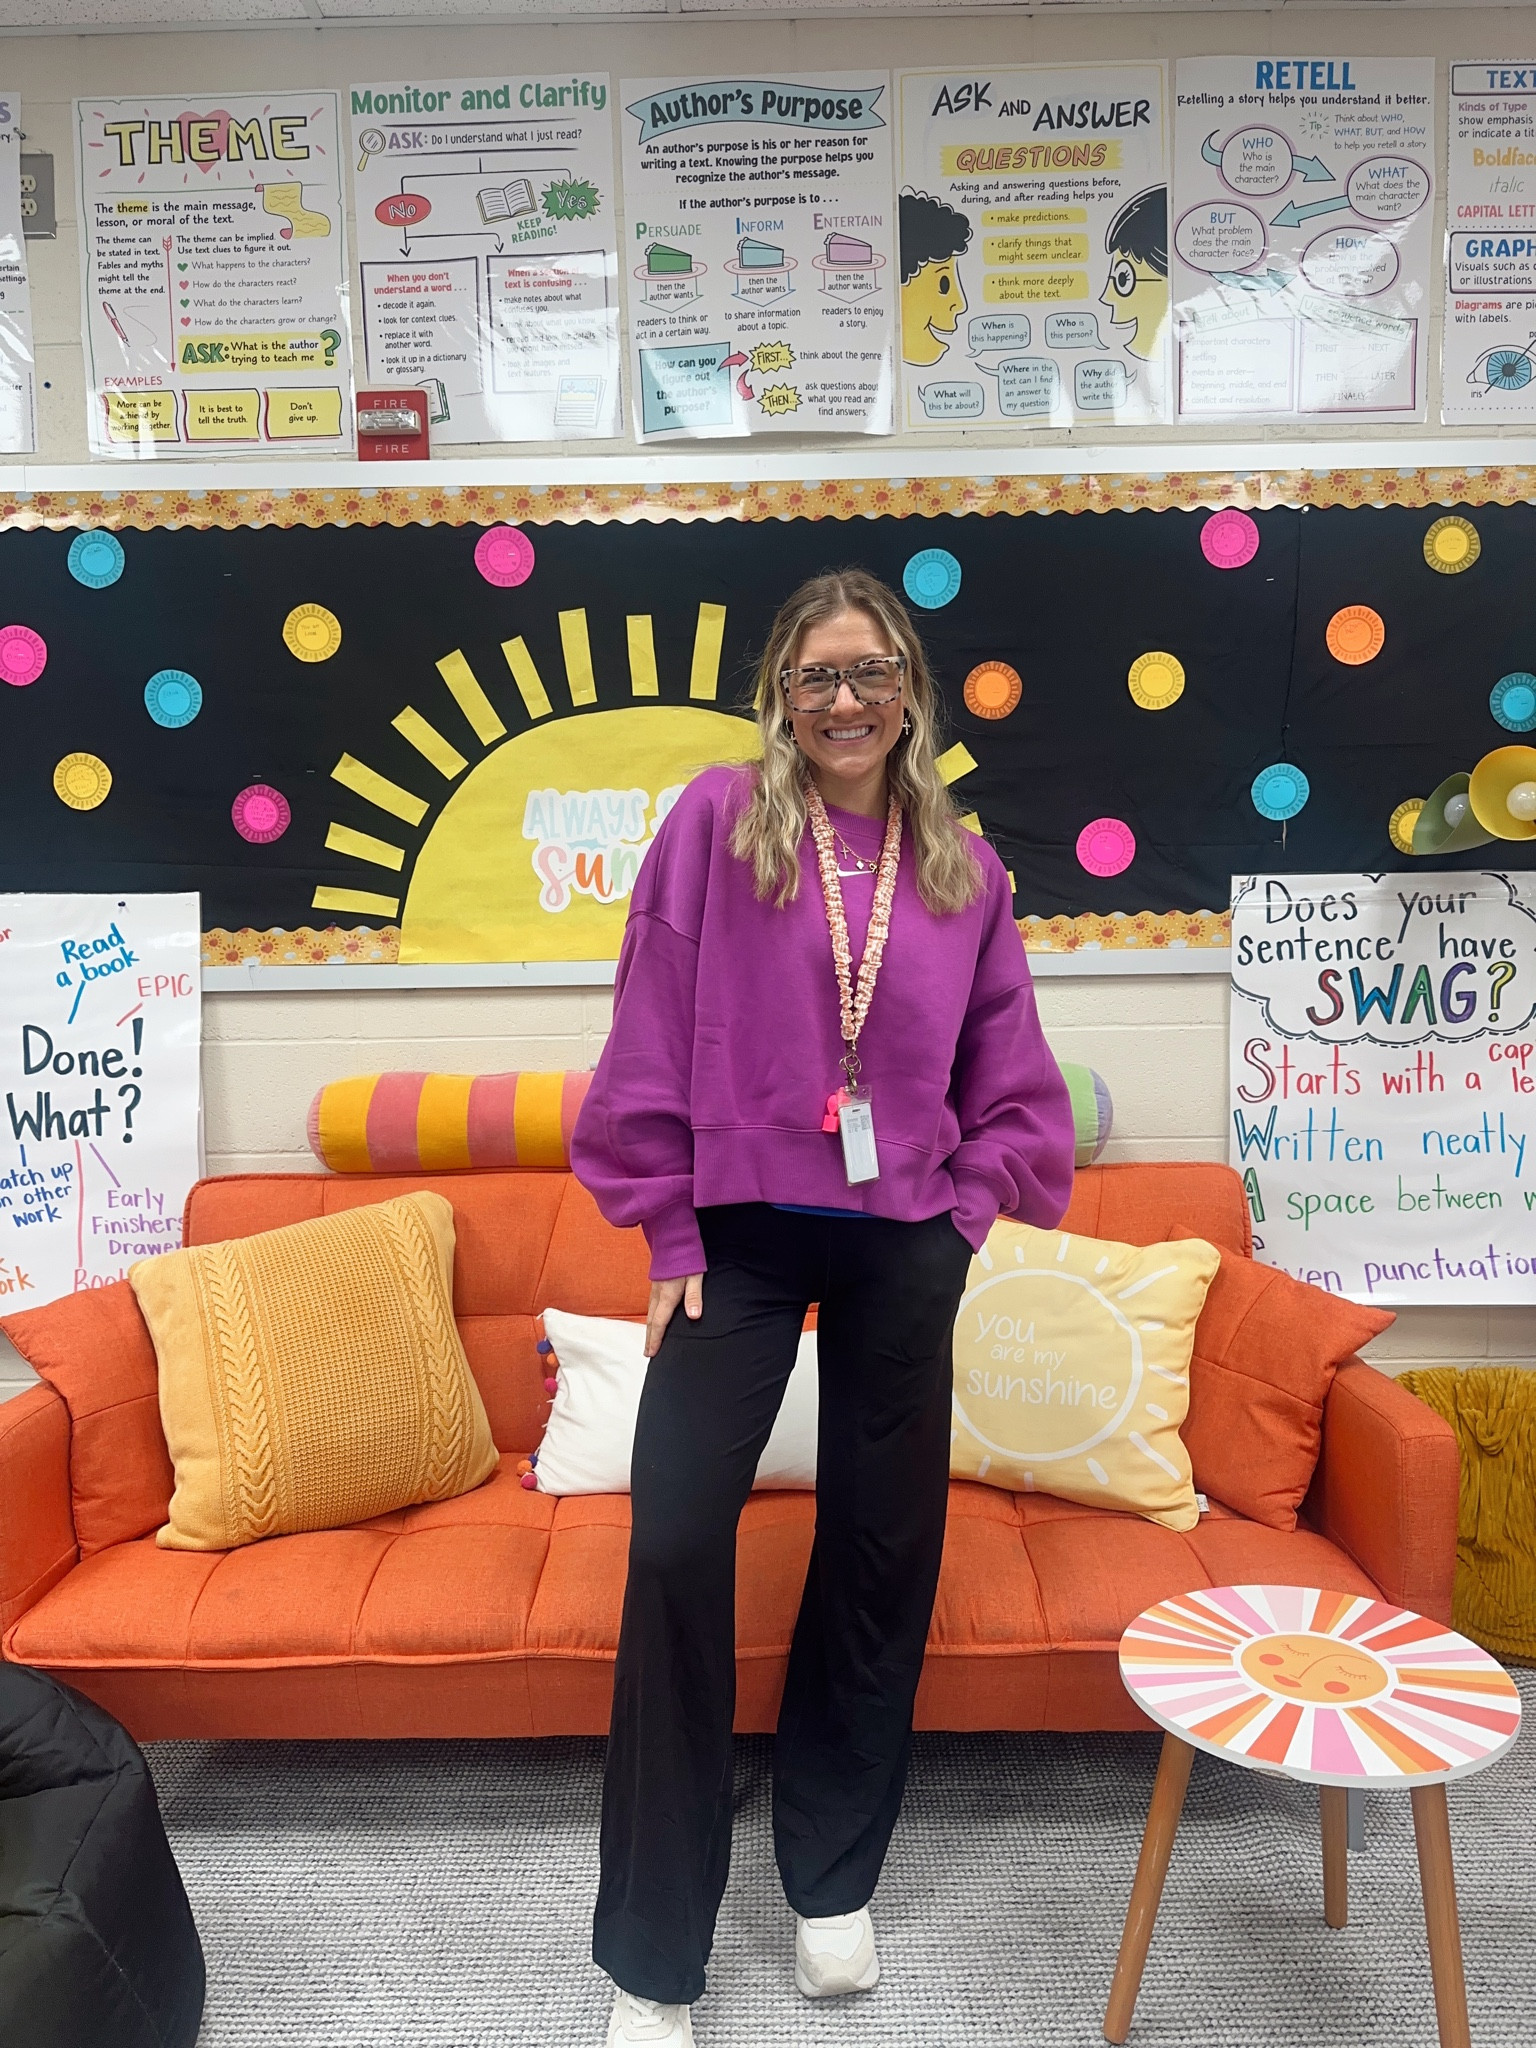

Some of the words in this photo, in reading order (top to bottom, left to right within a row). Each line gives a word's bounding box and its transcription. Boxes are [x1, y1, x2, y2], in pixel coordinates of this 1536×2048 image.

[1256, 61, 1356, 90] RETELL
[352, 85, 451, 115] Monitor
[461, 85, 510, 110] and
[520, 78, 607, 110] Clarify
[1177, 93, 1225, 108] Retelling
[1228, 95, 1234, 104] a
[1239, 95, 1265, 108] story
[1269, 95, 1296, 107] helps
[1300, 96, 1317, 108] you
[1322, 94, 1380, 105] understand
[1385, 95, 1391, 105] it
[1396, 95, 1430, 105] better.
[651, 89, 753, 128] Author's
[761, 90, 863, 123] Purpose
[931, 82, 992, 116] ASK
[998, 99, 1031, 117] AND
[1033, 100, 1151, 131] ANSWER
[1458, 103, 1486, 112] Kinds
[1489, 103, 1499, 111] of
[1502, 102, 1527, 112] Type
[1309, 122, 1322, 131] Tip
[1458, 116, 1483, 125] show
[1487, 115, 1533, 126] emphasis
[104, 116, 310, 166] THEME
[388, 132, 428, 149] ASK:
[432, 135, 442, 144] Do
[450, 132, 503, 143] understand
[506, 131, 527, 141] what
[536, 131, 553, 142] just
[556, 129, 582, 139] read?
[646, 145, 659, 154] An
[662, 143, 704, 154] author's
[707, 141, 748, 154] purpose
[751, 140, 759, 150] is
[763, 139, 777, 149] his
[780, 140, 791, 149] or
[794, 138, 812, 148] her
[815, 137, 849, 147] reason
[852, 136, 868, 146] for
[1243, 138, 1274, 149] WHO
[641, 158, 677, 171] writing
[680, 160, 686, 168] a
[689, 158, 713, 168] text.
[716, 156, 758, 168] Knowing
[761, 155, 777, 165] the
[781, 154, 822, 166] purpose
[825, 152, 853, 163] helps
[856, 152, 874, 162] you
[957, 144, 1107, 173] QUESTIONS
[1243, 152, 1263, 161] Who
[1265, 153, 1272, 161] is
[1239, 164, 1252, 172] the
[1255, 164, 1275, 172] main
[1368, 167, 1408, 179] WHAT
[950, 182, 979, 193] Asking
[983, 182, 999, 190] and
[1002, 180, 1045, 191] answering
[1049, 178, 1089, 189] questions
[1092, 177, 1121, 187] before,
[1235, 175, 1279, 184] character?
[1490, 176, 1524, 193] italic
[95, 204, 113, 214] The
[117, 203, 148, 213] theme
[152, 202, 159, 212] is
[162, 202, 180, 211] the
[183, 201, 208, 211] main
[212, 201, 257, 211] message,
[557, 190, 587, 208] Yes
[389, 203, 417, 219] No
[997, 214, 1020, 222] make
[1023, 212, 1070, 224] predictions.
[1210, 212, 1236, 224] BUT
[1457, 205, 1503, 218] CAPITAL
[517, 217, 541, 230] KEEP
[736, 218, 784, 235] INFORM
[813, 213, 882, 230] ENTERTAIN
[636, 222, 702, 240] PERSUADE
[192, 261, 213, 269] What
[216, 261, 244, 271] happens
[247, 260, 254, 268] to
[257, 260, 269, 268] the
[272, 258, 311, 267] characters?
[387, 274, 409, 282] When
[412, 274, 426, 282] you
[429, 271, 449, 281] don't
[998, 277, 1019, 286] think
[1048, 276, 1074, 287] deeply
[374, 285, 421, 294] understand
[431, 283, 452, 292] word
[383, 301, 406, 309] decode
[409, 300, 414, 308] it
[1455, 300, 1502, 310] Diagrams
[1455, 314, 1476, 323] with
[1479, 314, 1511, 323] labels.
[182, 344, 230, 364] ASK:
[800, 351, 818, 360] think
[821, 351, 842, 359] about
[845, 351, 858, 359] the
[104, 376, 162, 386] EXAMPLES
[1471, 390, 1482, 398] iris
[290, 402, 313, 410] Don't
[374, 400, 408, 408] FIRE
[288, 414, 305, 423] give
[307, 415, 318, 423] up.
[375, 445, 409, 453] FIRE
[528, 796, 643, 840] ALWAYS
[1265, 880, 1359, 924] Does
[1397, 890, 1477, 944] your
[61, 922, 125, 965] Read
[1237, 926, 1395, 966] sentence
[1439, 923, 1517, 960] have
[56, 969, 72, 987] a
[82, 947, 140, 982] book
[138, 973, 193, 999] EPIC
[1306, 961, 1517, 1027] SWAG?
[23, 1017, 144, 1079] Done!
[1237, 1038, 1362, 1104] Starts
[1383, 1050, 1445, 1096] with
[1465, 1071, 1482, 1091] a
[7, 1083, 142, 1144] What?
[1234, 1105, 1383, 1162] Written
[1423, 1111, 1526, 1178] neatly
[52, 1162, 74, 1180] up
[24, 1183, 72, 1207] other
[107, 1188, 164, 1211] Early
[1243, 1167, 1266, 1224] A
[1287, 1191, 1375, 1231] space
[1397, 1173, 1502, 1214] between
[13, 1204, 63, 1229] work
[92, 1214, 185, 1236] Finishers
[975, 1312, 1035, 1344] you
[990, 1344, 1025, 1364] are
[1034, 1350, 1066, 1371] my
[966, 1369, 1118, 1410] sunshine
